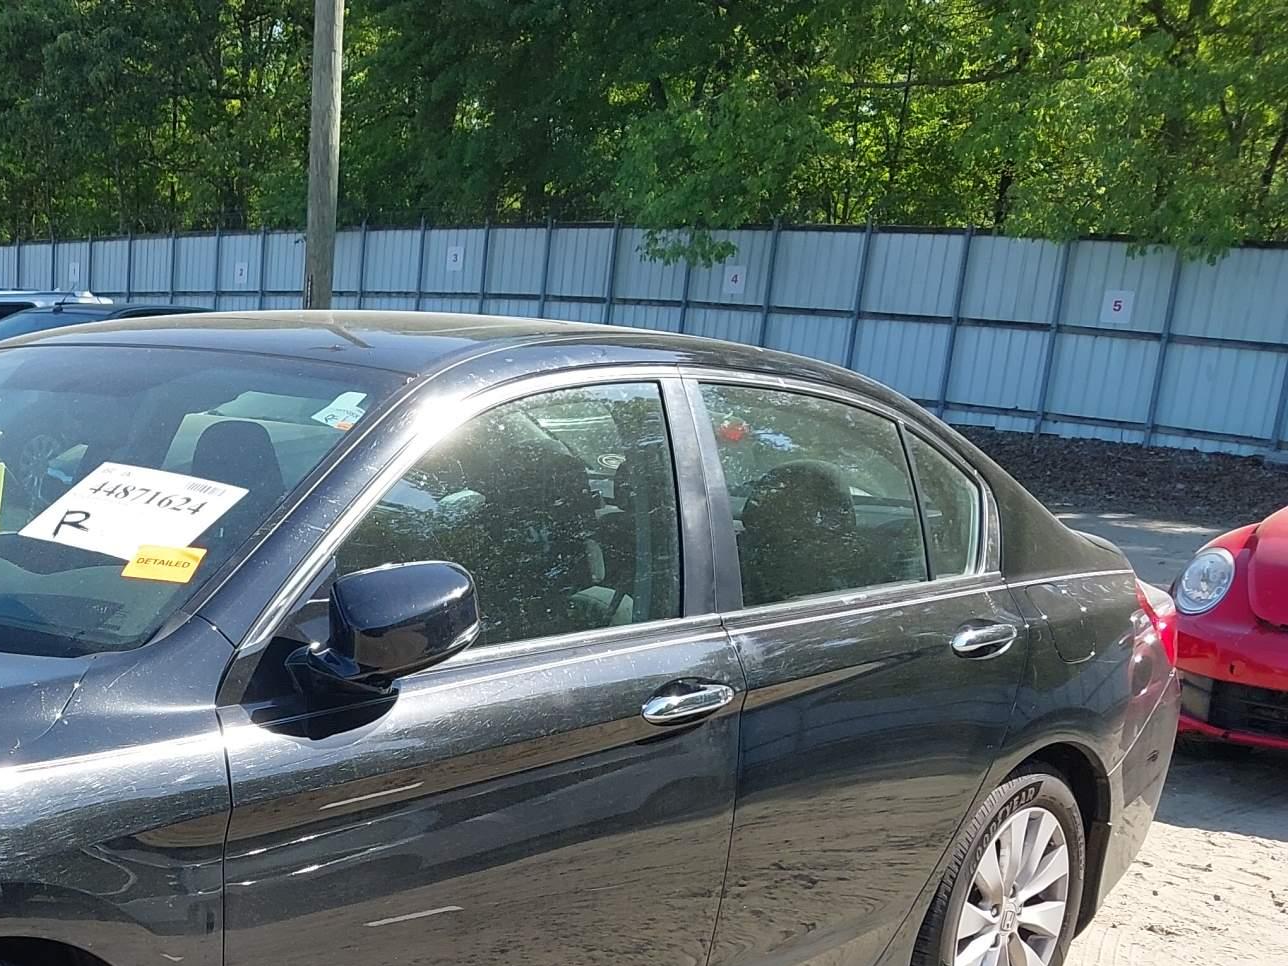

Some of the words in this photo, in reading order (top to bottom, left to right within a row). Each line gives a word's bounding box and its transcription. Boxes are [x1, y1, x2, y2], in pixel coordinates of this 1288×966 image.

[730, 274, 738, 285] 4
[1112, 299, 1123, 312] 5
[88, 480, 208, 516] 44871624
[52, 508, 91, 538] R
[136, 557, 191, 569] DETAILED
